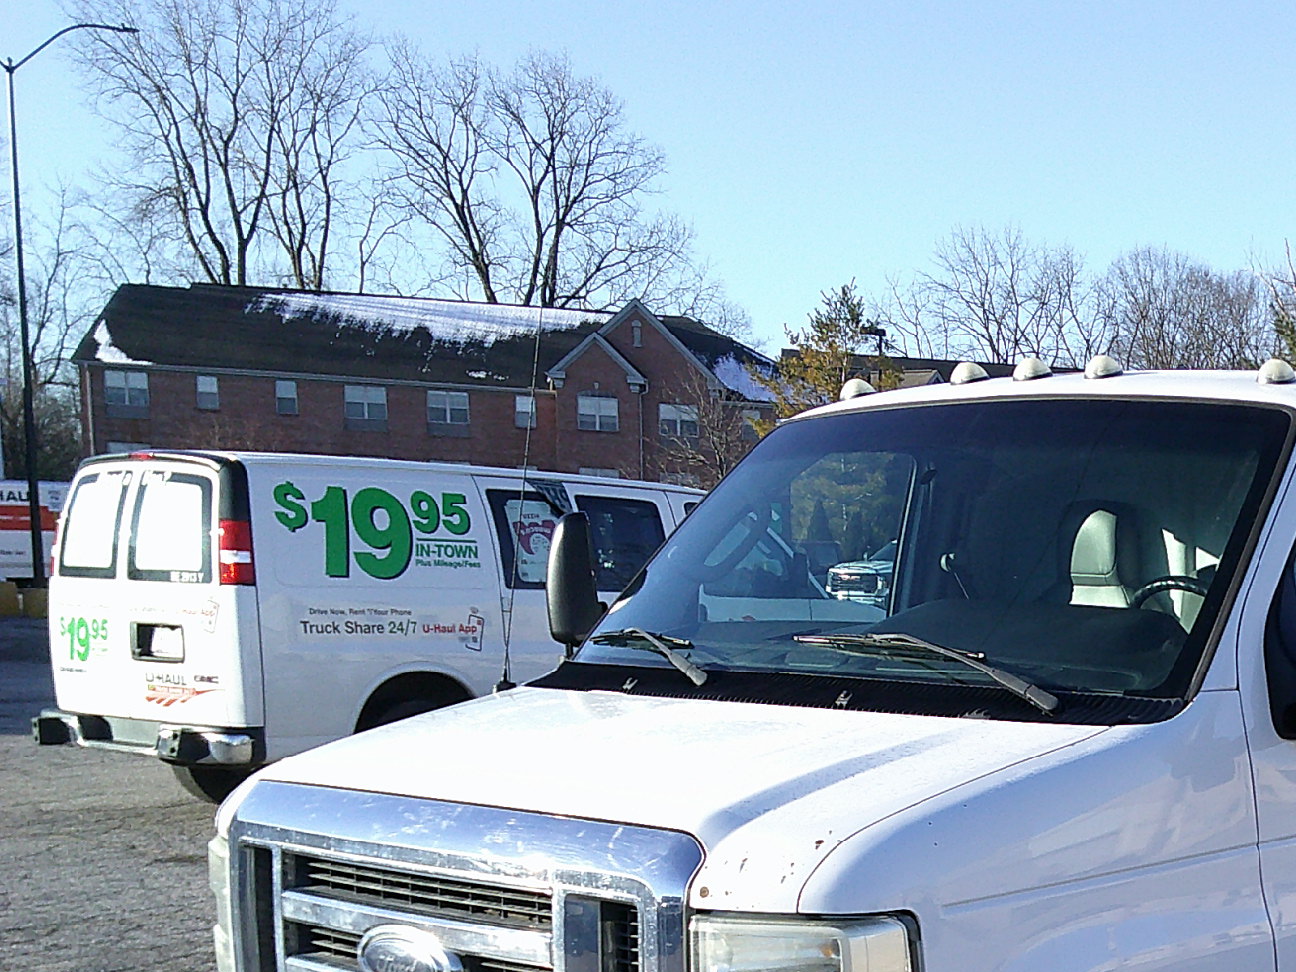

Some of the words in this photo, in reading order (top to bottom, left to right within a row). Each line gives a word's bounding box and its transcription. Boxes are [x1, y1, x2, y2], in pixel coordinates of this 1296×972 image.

[415, 542, 479, 559] IN-TOWN
[309, 607, 329, 616] Drive
[348, 608, 366, 616] Rent
[300, 620, 342, 635] Truck
[344, 620, 384, 635] Share
[387, 619, 418, 637] 24/7
[422, 624, 456, 634] U-Haul
[458, 623, 478, 635] App
